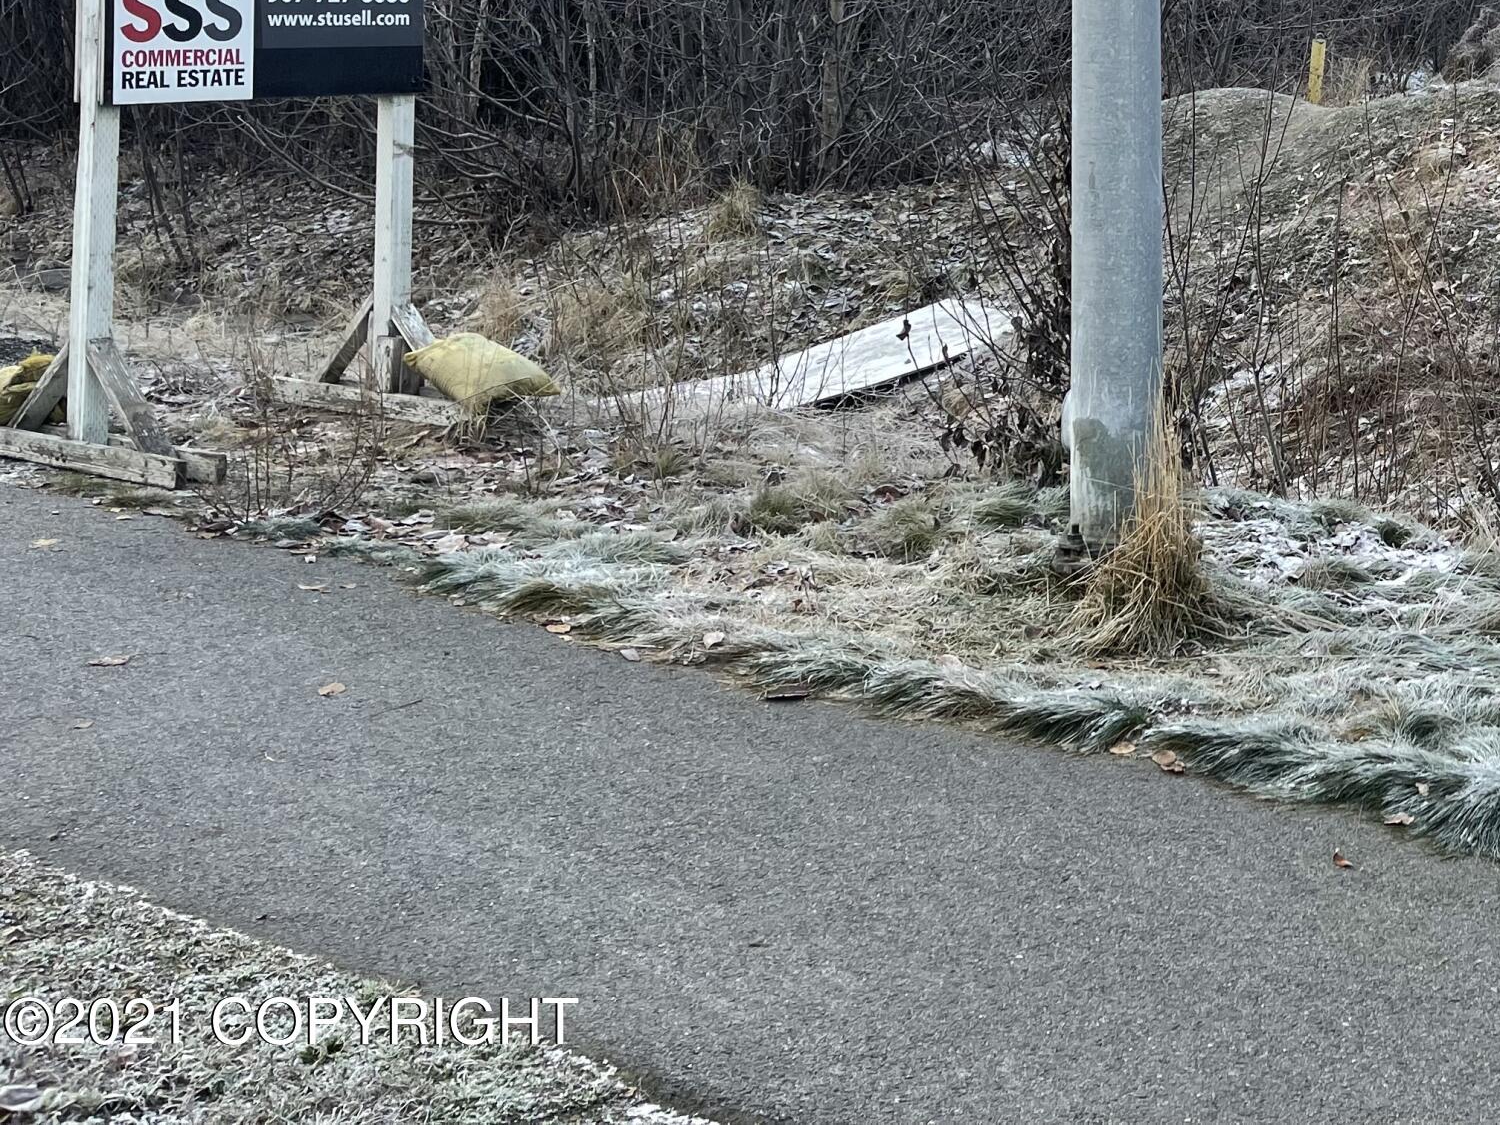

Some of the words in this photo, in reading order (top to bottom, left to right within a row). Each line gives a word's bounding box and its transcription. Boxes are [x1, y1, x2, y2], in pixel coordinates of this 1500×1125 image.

[267, 10, 410, 27] www.stusell.com
[121, 48, 245, 68] COMMERCIAL
[121, 71, 170, 89] REAL
[177, 68, 245, 88] ESTATE
